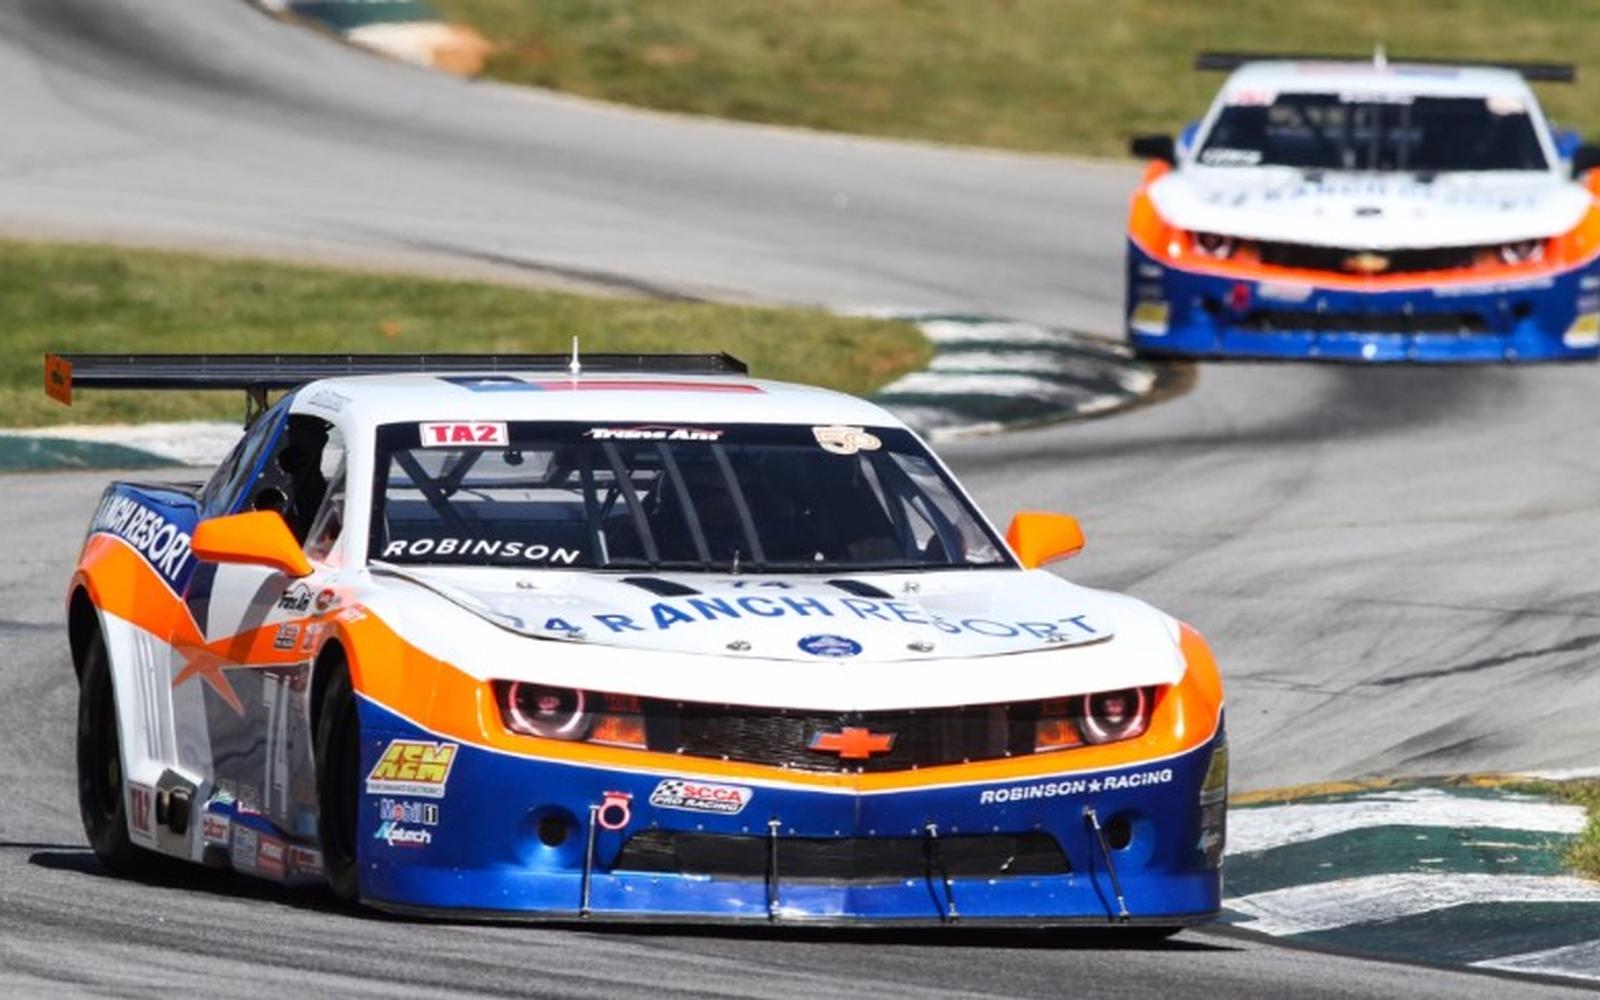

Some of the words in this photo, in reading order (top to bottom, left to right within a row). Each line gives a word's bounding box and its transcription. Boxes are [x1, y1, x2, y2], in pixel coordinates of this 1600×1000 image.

[429, 426, 499, 443] TA2
[668, 428, 720, 440] Am
[383, 539, 580, 564] ROBINSON
[593, 596, 834, 632] RANCH
[838, 597, 1096, 639] RESORT
[684, 785, 742, 801] SCCA
[980, 780, 1086, 804] ROBINSON
[1103, 769, 1173, 791] RACING
[380, 799, 423, 824] Mobil
[684, 799, 738, 811] RACING
